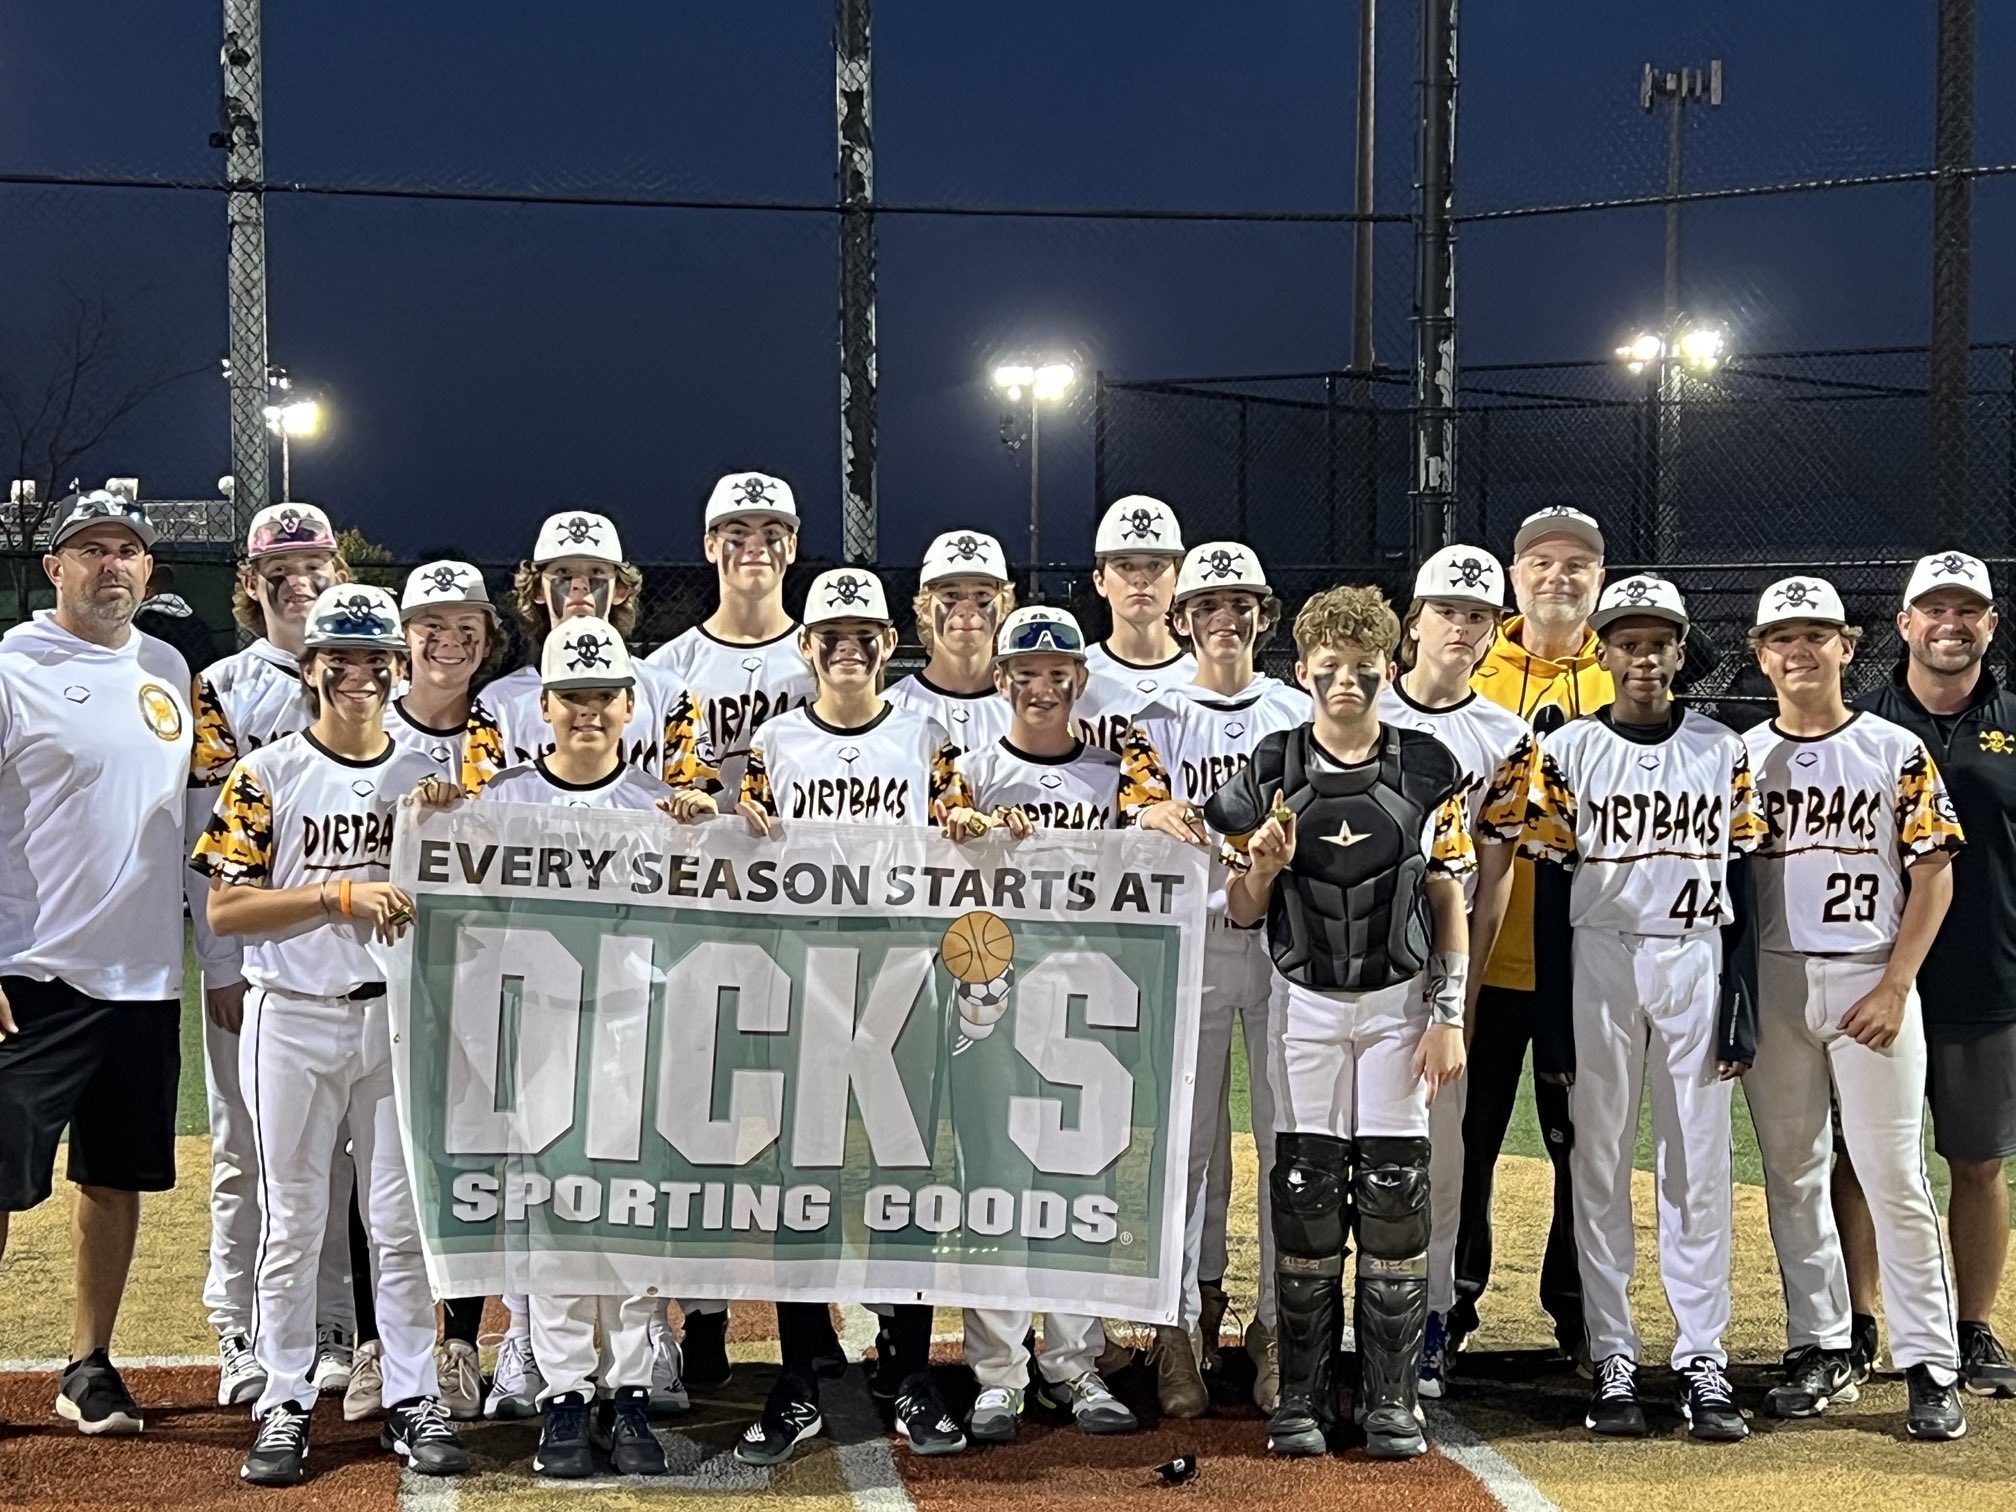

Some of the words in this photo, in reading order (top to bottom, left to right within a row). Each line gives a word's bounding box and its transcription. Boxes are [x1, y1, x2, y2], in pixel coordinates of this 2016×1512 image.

[792, 775, 909, 820] DIRTBAGS
[417, 839, 617, 890] EVERY
[630, 854, 870, 906] SEASON
[884, 863, 1097, 912] STARTS
[1110, 872, 1186, 914] AT
[1668, 878, 1724, 929] 44
[1822, 872, 1880, 923] 23
[444, 909, 1139, 1176] DICK'S
[451, 1173, 831, 1232] SPORTING
[863, 1184, 1119, 1244] GOODS
